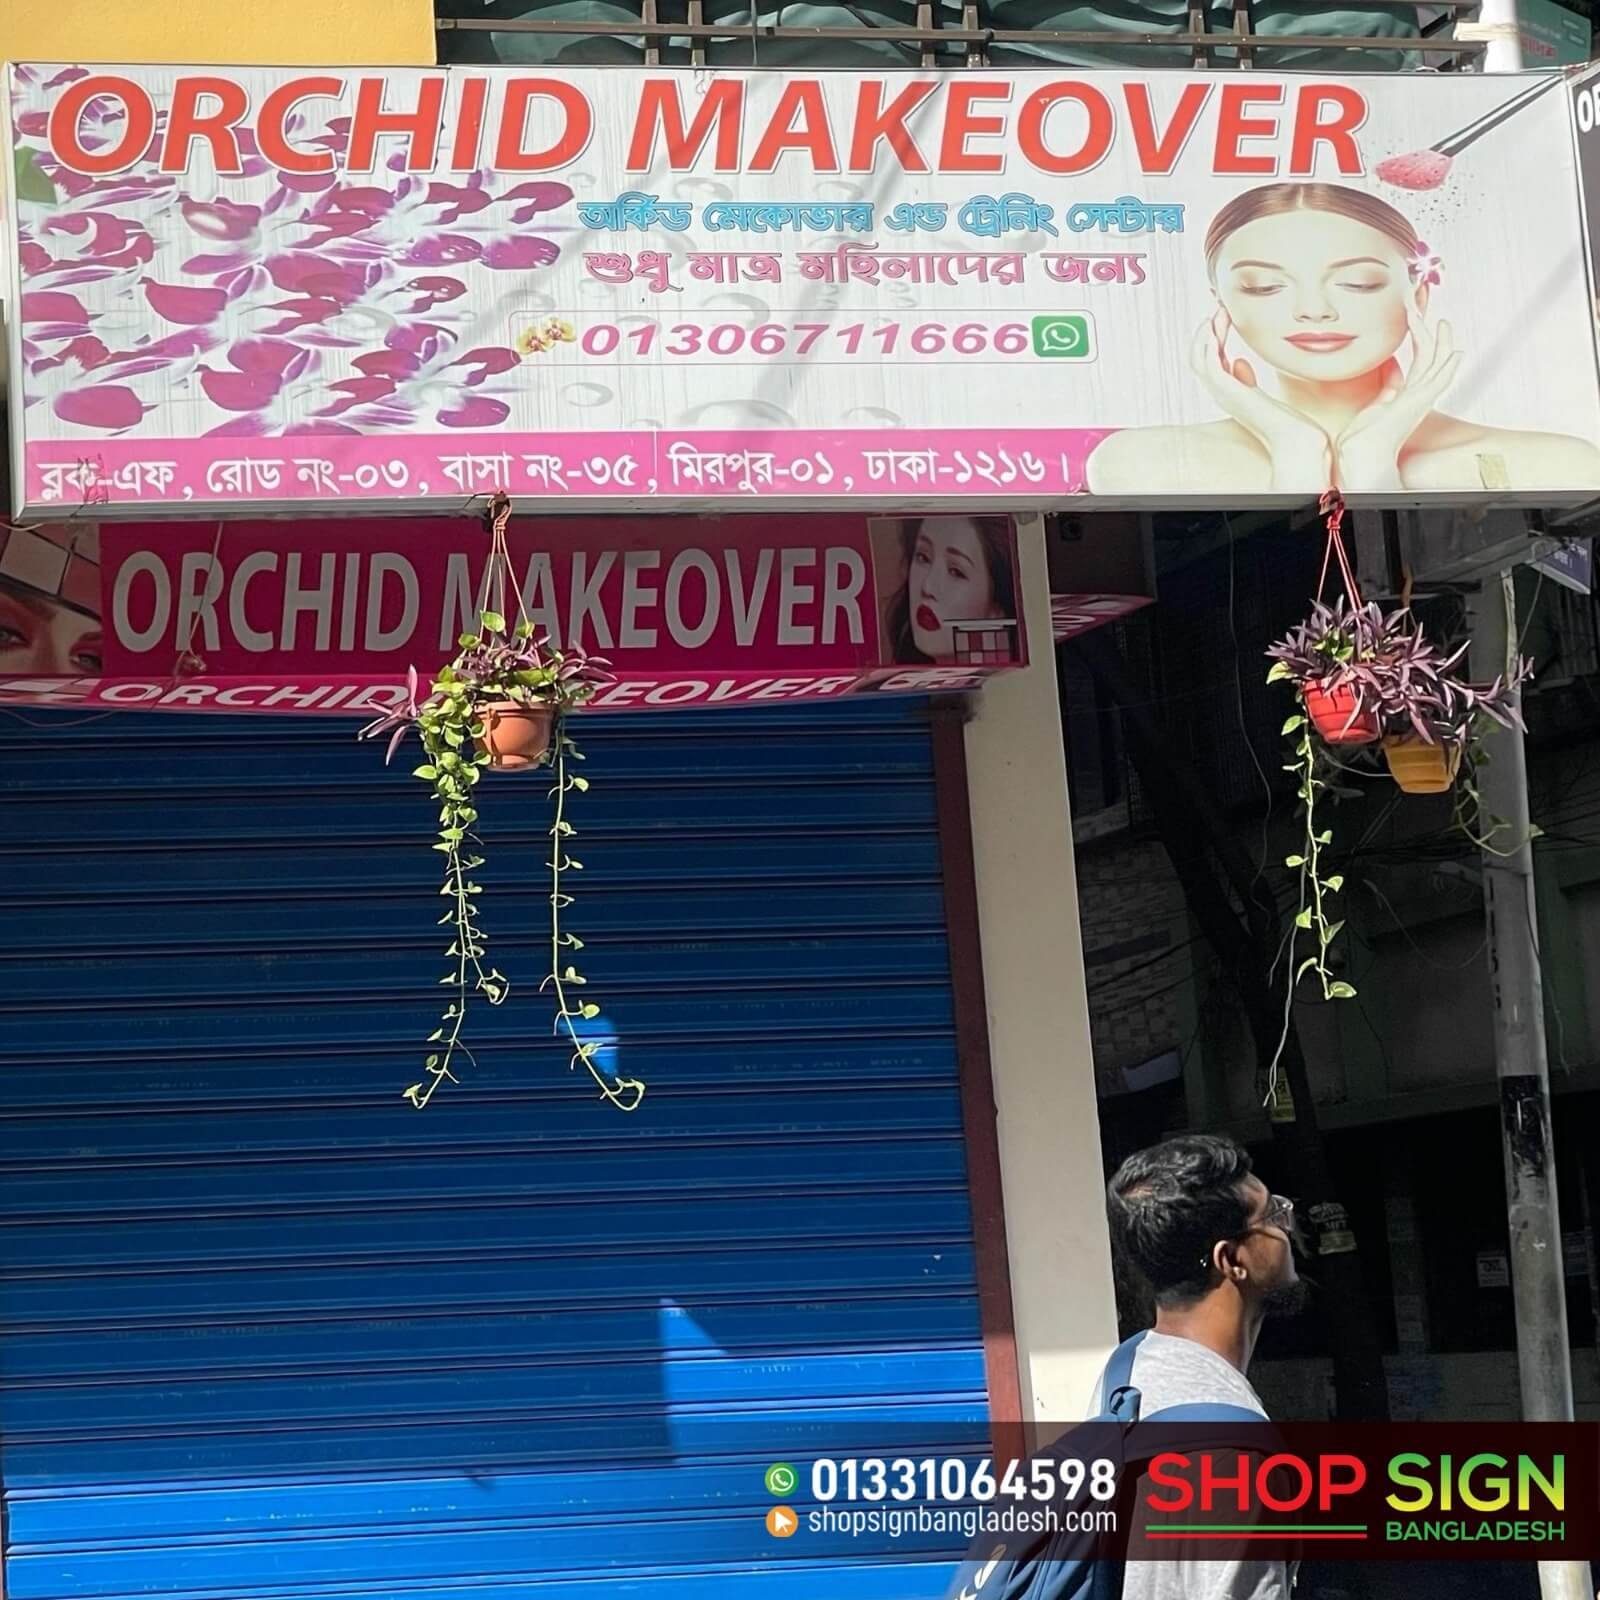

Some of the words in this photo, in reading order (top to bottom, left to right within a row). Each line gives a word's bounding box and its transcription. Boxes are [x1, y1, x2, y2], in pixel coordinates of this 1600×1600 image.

[48, 75, 593, 175] ORCHID
[625, 78, 1368, 177] MAKEOVER
[577, 191, 692, 232] অর্কিড
[703, 202, 874, 233] মেকোভার
[958, 192, 1059, 237] ট্রেনিং
[1066, 196, 1185, 233] সেন্টার
[582, 250, 684, 293] শুধু
[686, 252, 782, 283] মাত্র
[796, 241, 1027, 286] মহিলাদের
[1040, 252, 1147, 286] জন্য
[581, 322, 1030, 356] 01306711666
[207, 457, 285, 493] রোড
[438, 451, 514, 489] বাসা
[112, 550, 420, 653] ORCHID
[440, 547, 866, 651] MAKEOVER
[100, 684, 411, 708] ORCHID
